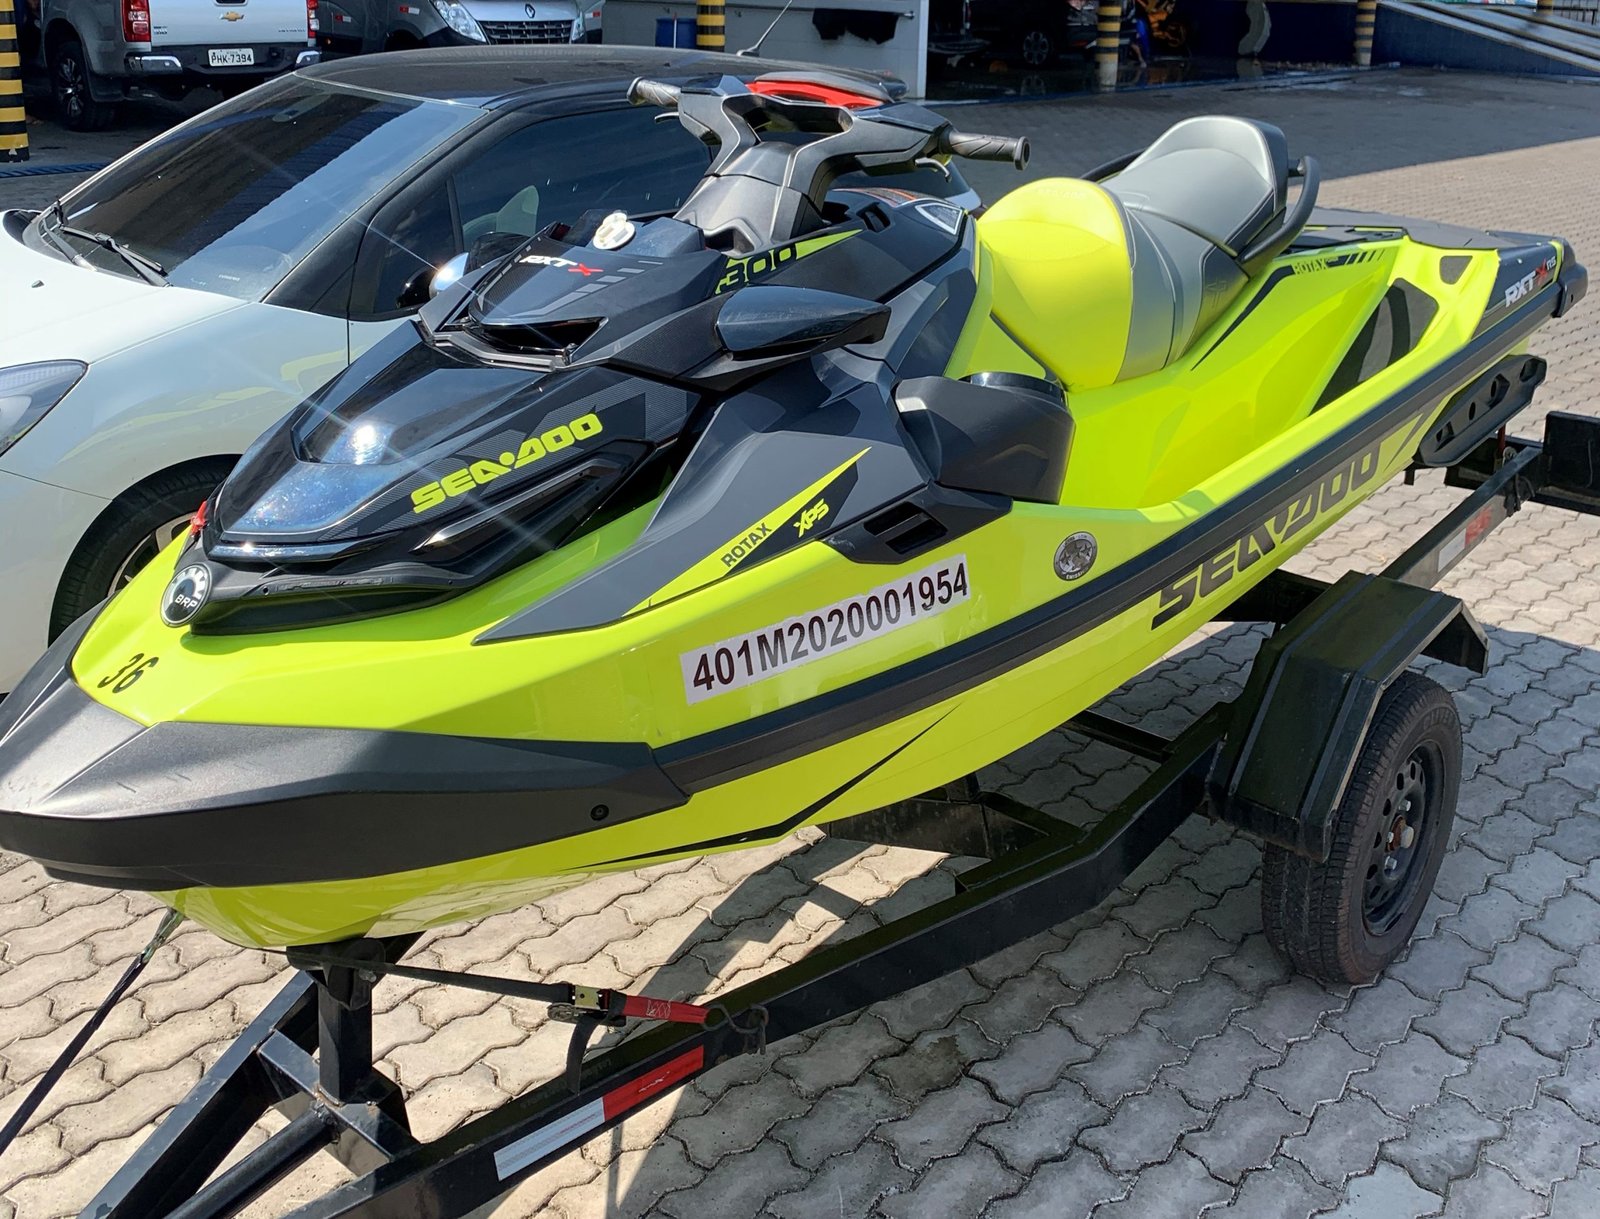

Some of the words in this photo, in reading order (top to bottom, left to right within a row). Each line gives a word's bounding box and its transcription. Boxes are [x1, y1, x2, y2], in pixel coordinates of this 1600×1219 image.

[718, 243, 798, 290] 300
[793, 498, 830, 538] XPS
[720, 522, 772, 567] ROTAX
[174, 593, 199, 609] BRP
[692, 562, 968, 691] 401M2020001954
[96, 652, 160, 694] 36
